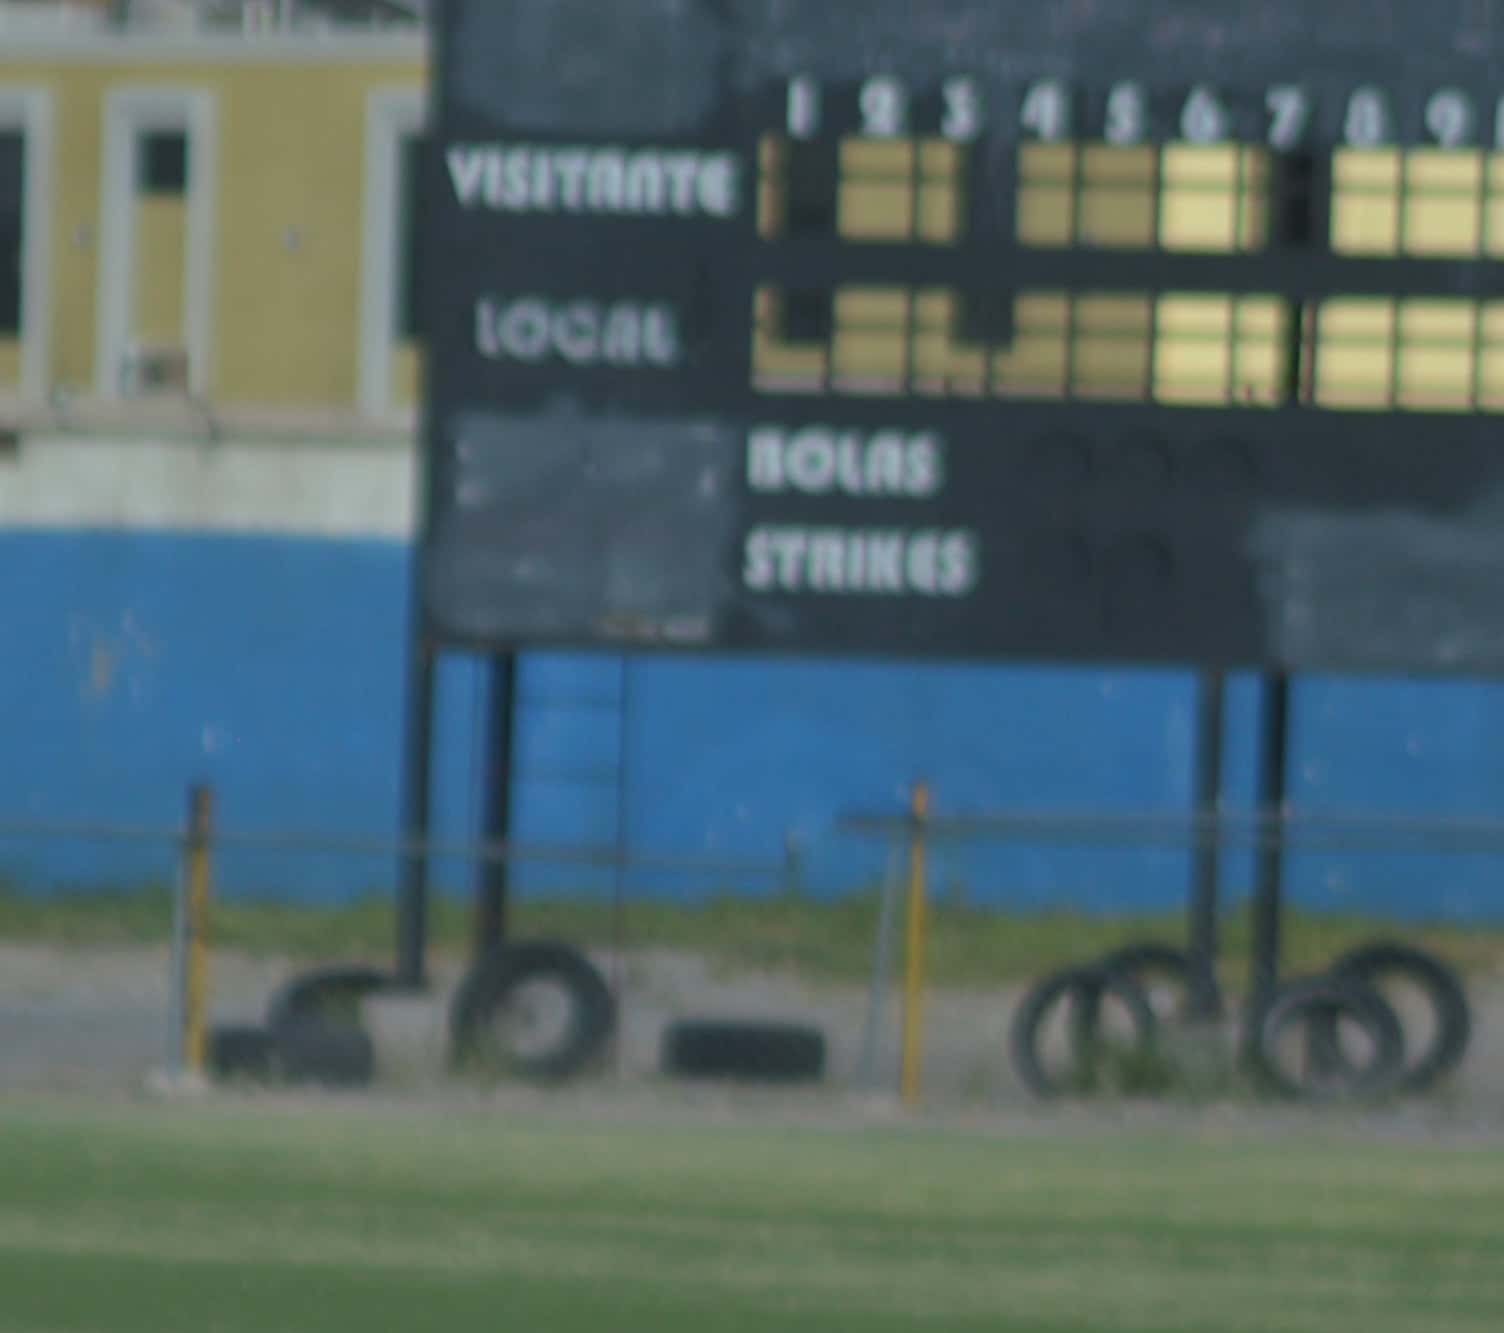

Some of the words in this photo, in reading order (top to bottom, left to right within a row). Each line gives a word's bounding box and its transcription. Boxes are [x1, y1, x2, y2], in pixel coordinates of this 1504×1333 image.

[788, 74, 816, 139] 1
[860, 77, 903, 136] 2
[943, 76, 977, 140] 3
[1021, 80, 1062, 141] 4
[1106, 80, 1141, 142] 5
[1181, 84, 1221, 142] 6
[1265, 86, 1303, 149] 7
[1345, 88, 1383, 146] 8
[1425, 88, 1469, 147] 9
[447, 141, 738, 217] VISITANTE
[476, 294, 674, 366] LOCAL
[747, 426, 939, 495] BOLAS
[743, 526, 974, 597] STRIKES
